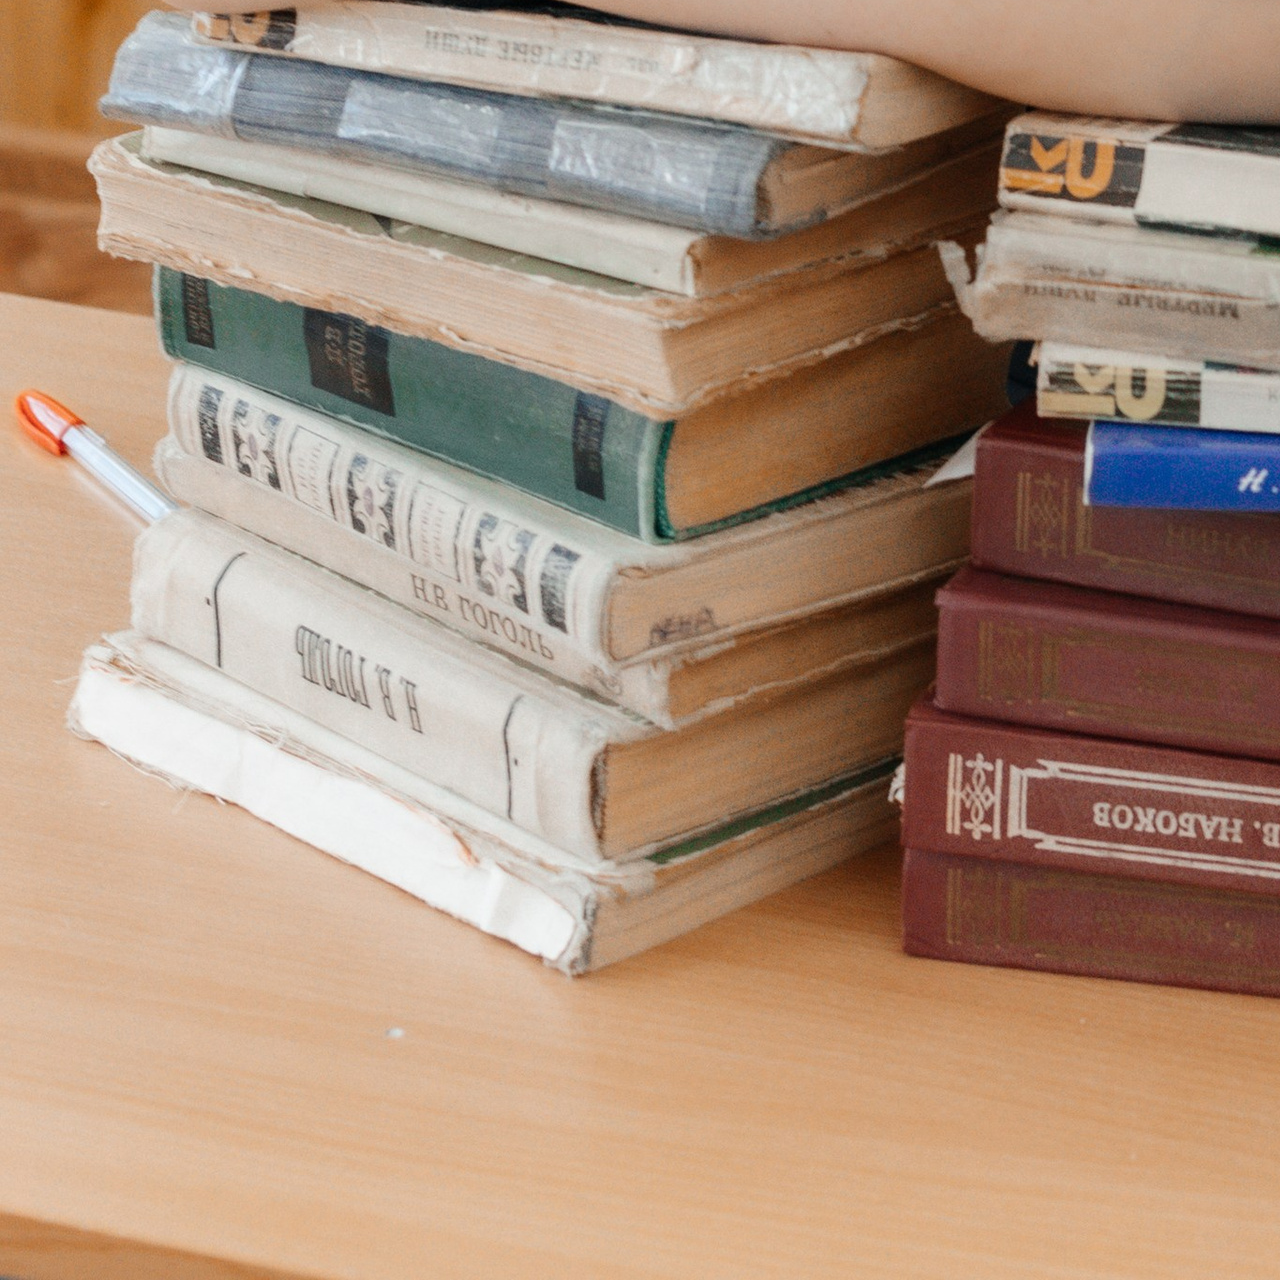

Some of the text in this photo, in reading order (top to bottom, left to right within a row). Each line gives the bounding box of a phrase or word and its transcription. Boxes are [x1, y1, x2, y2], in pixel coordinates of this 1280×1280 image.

[457, 593, 555, 661] ГОГОЛЬ
[295, 624, 373, 711] ГОГОЛЬ
[1092, 801, 1244, 844] НАБОКОВ
